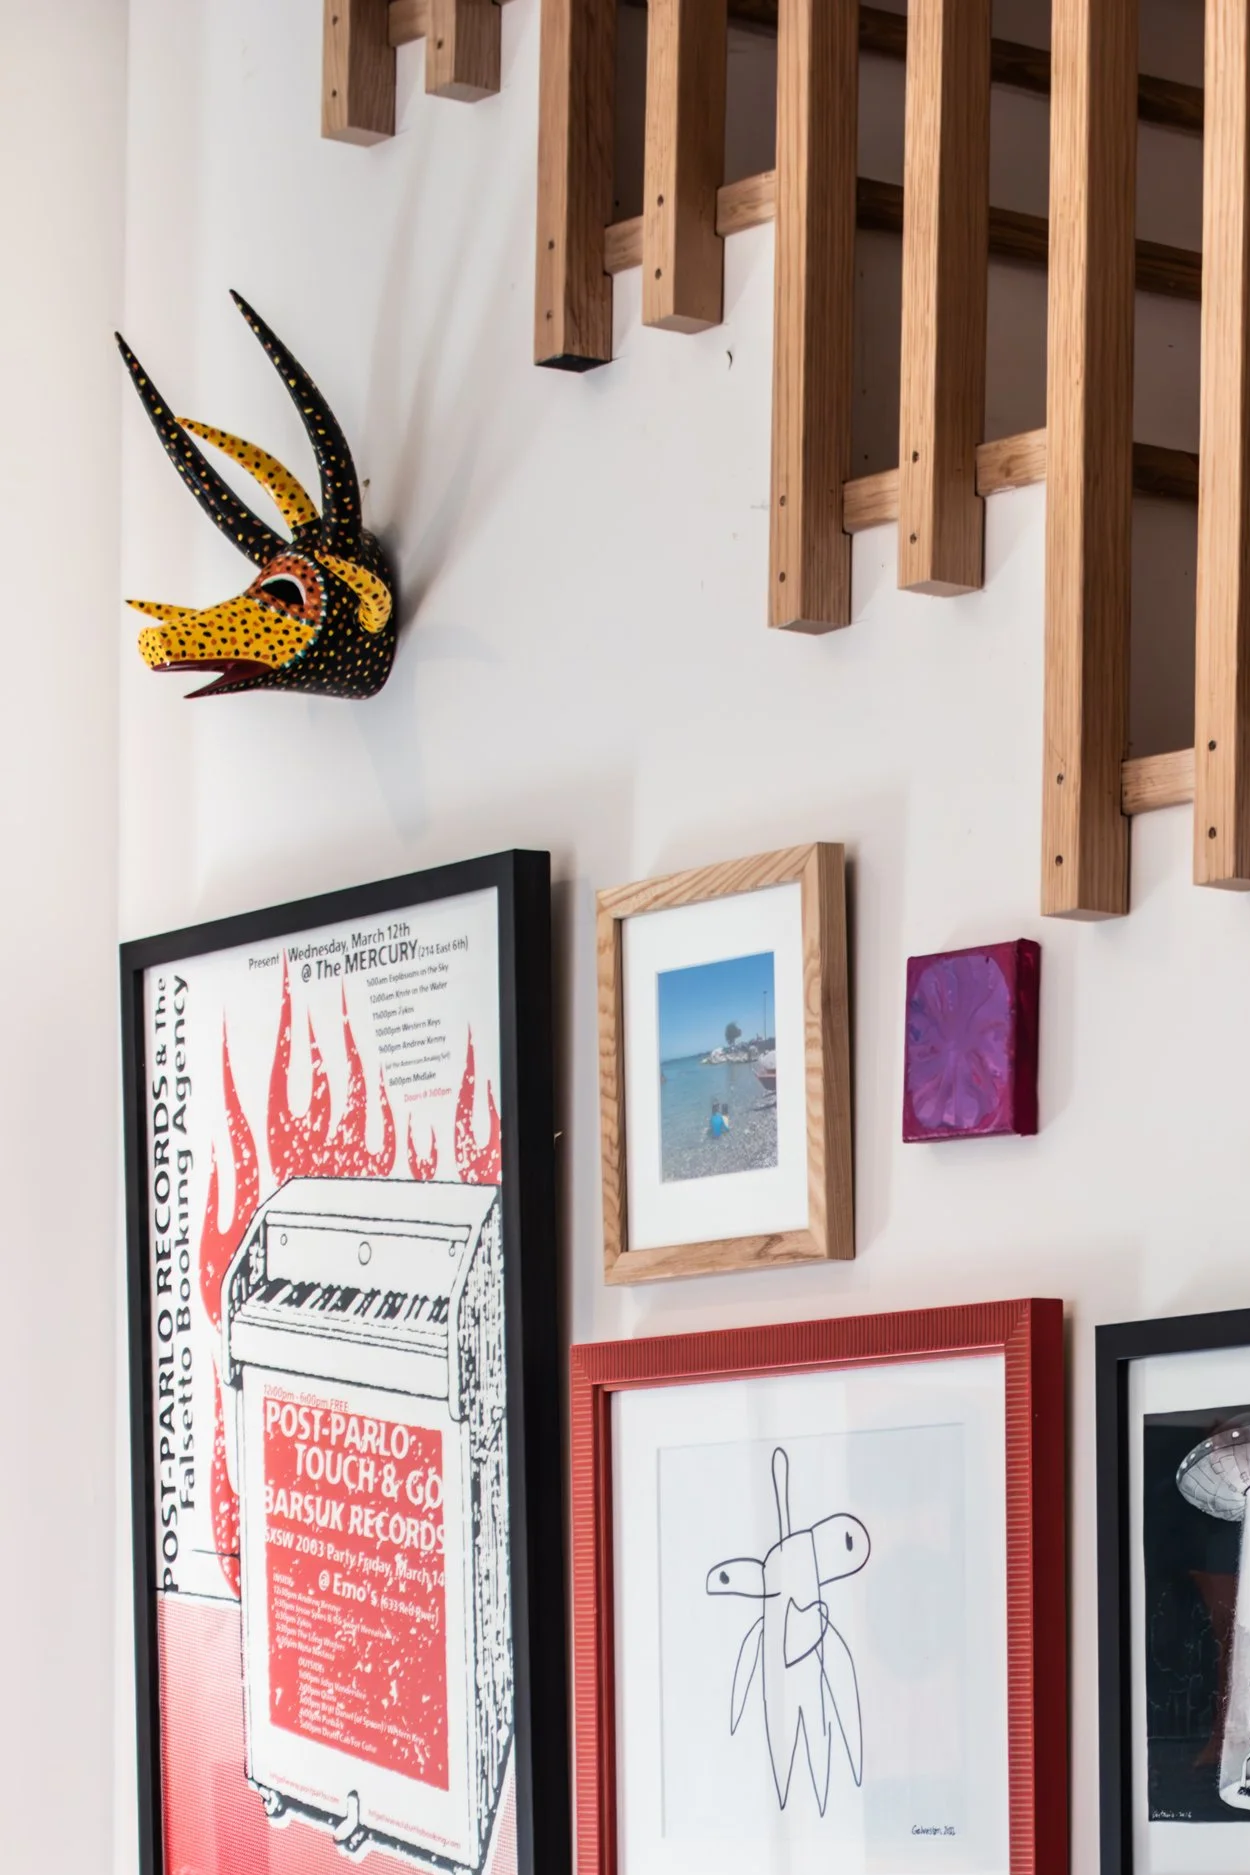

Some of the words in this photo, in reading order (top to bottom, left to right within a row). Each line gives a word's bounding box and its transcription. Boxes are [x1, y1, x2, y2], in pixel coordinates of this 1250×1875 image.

[248, 953, 280, 970] Present
[287, 938, 349, 963] Wednesday,
[351, 928, 385, 949] March
[387, 922, 410, 940] 12th
[301, 963, 312, 984] @
[315, 959, 342, 980] The
[344, 939, 418, 975] MERCURY
[418, 944, 435, 958] (214
[435, 942, 451, 955] East
[452, 935, 469, 951] 6th)
[156, 977, 167, 1031] The
[156, 1044, 167, 1065] &
[173, 975, 193, 1135] Agency
[152, 1074, 173, 1296] RECORDS
[174, 1149, 194, 1333] Booking
[158, 1309, 179, 1593] POST-PARLO
[178, 1347, 195, 1511] Falsetto
[266, 1401, 410, 1459] POST-PARLO
[295, 1443, 375, 1494] TOUCH
[381, 1463, 398, 1499] &
[405, 1470, 443, 1508] GO
[264, 1486, 345, 1531] BARSUK
[348, 1504, 445, 1555] RECORDS
[265, 1527, 294, 1549] SXSW
[296, 1535, 324, 1558] 2003
[327, 1544, 356, 1570] Party
[358, 1552, 393, 1577] Friday,
[395, 1557, 430, 1584] March
[432, 1571, 445, 1587] 14
[319, 1570, 330, 1591] @
[333, 1573, 377, 1606] Emo's
[381, 1594, 399, 1612] (633
[399, 1601, 414, 1617] Red
[414, 1605, 439, 1627] River)
